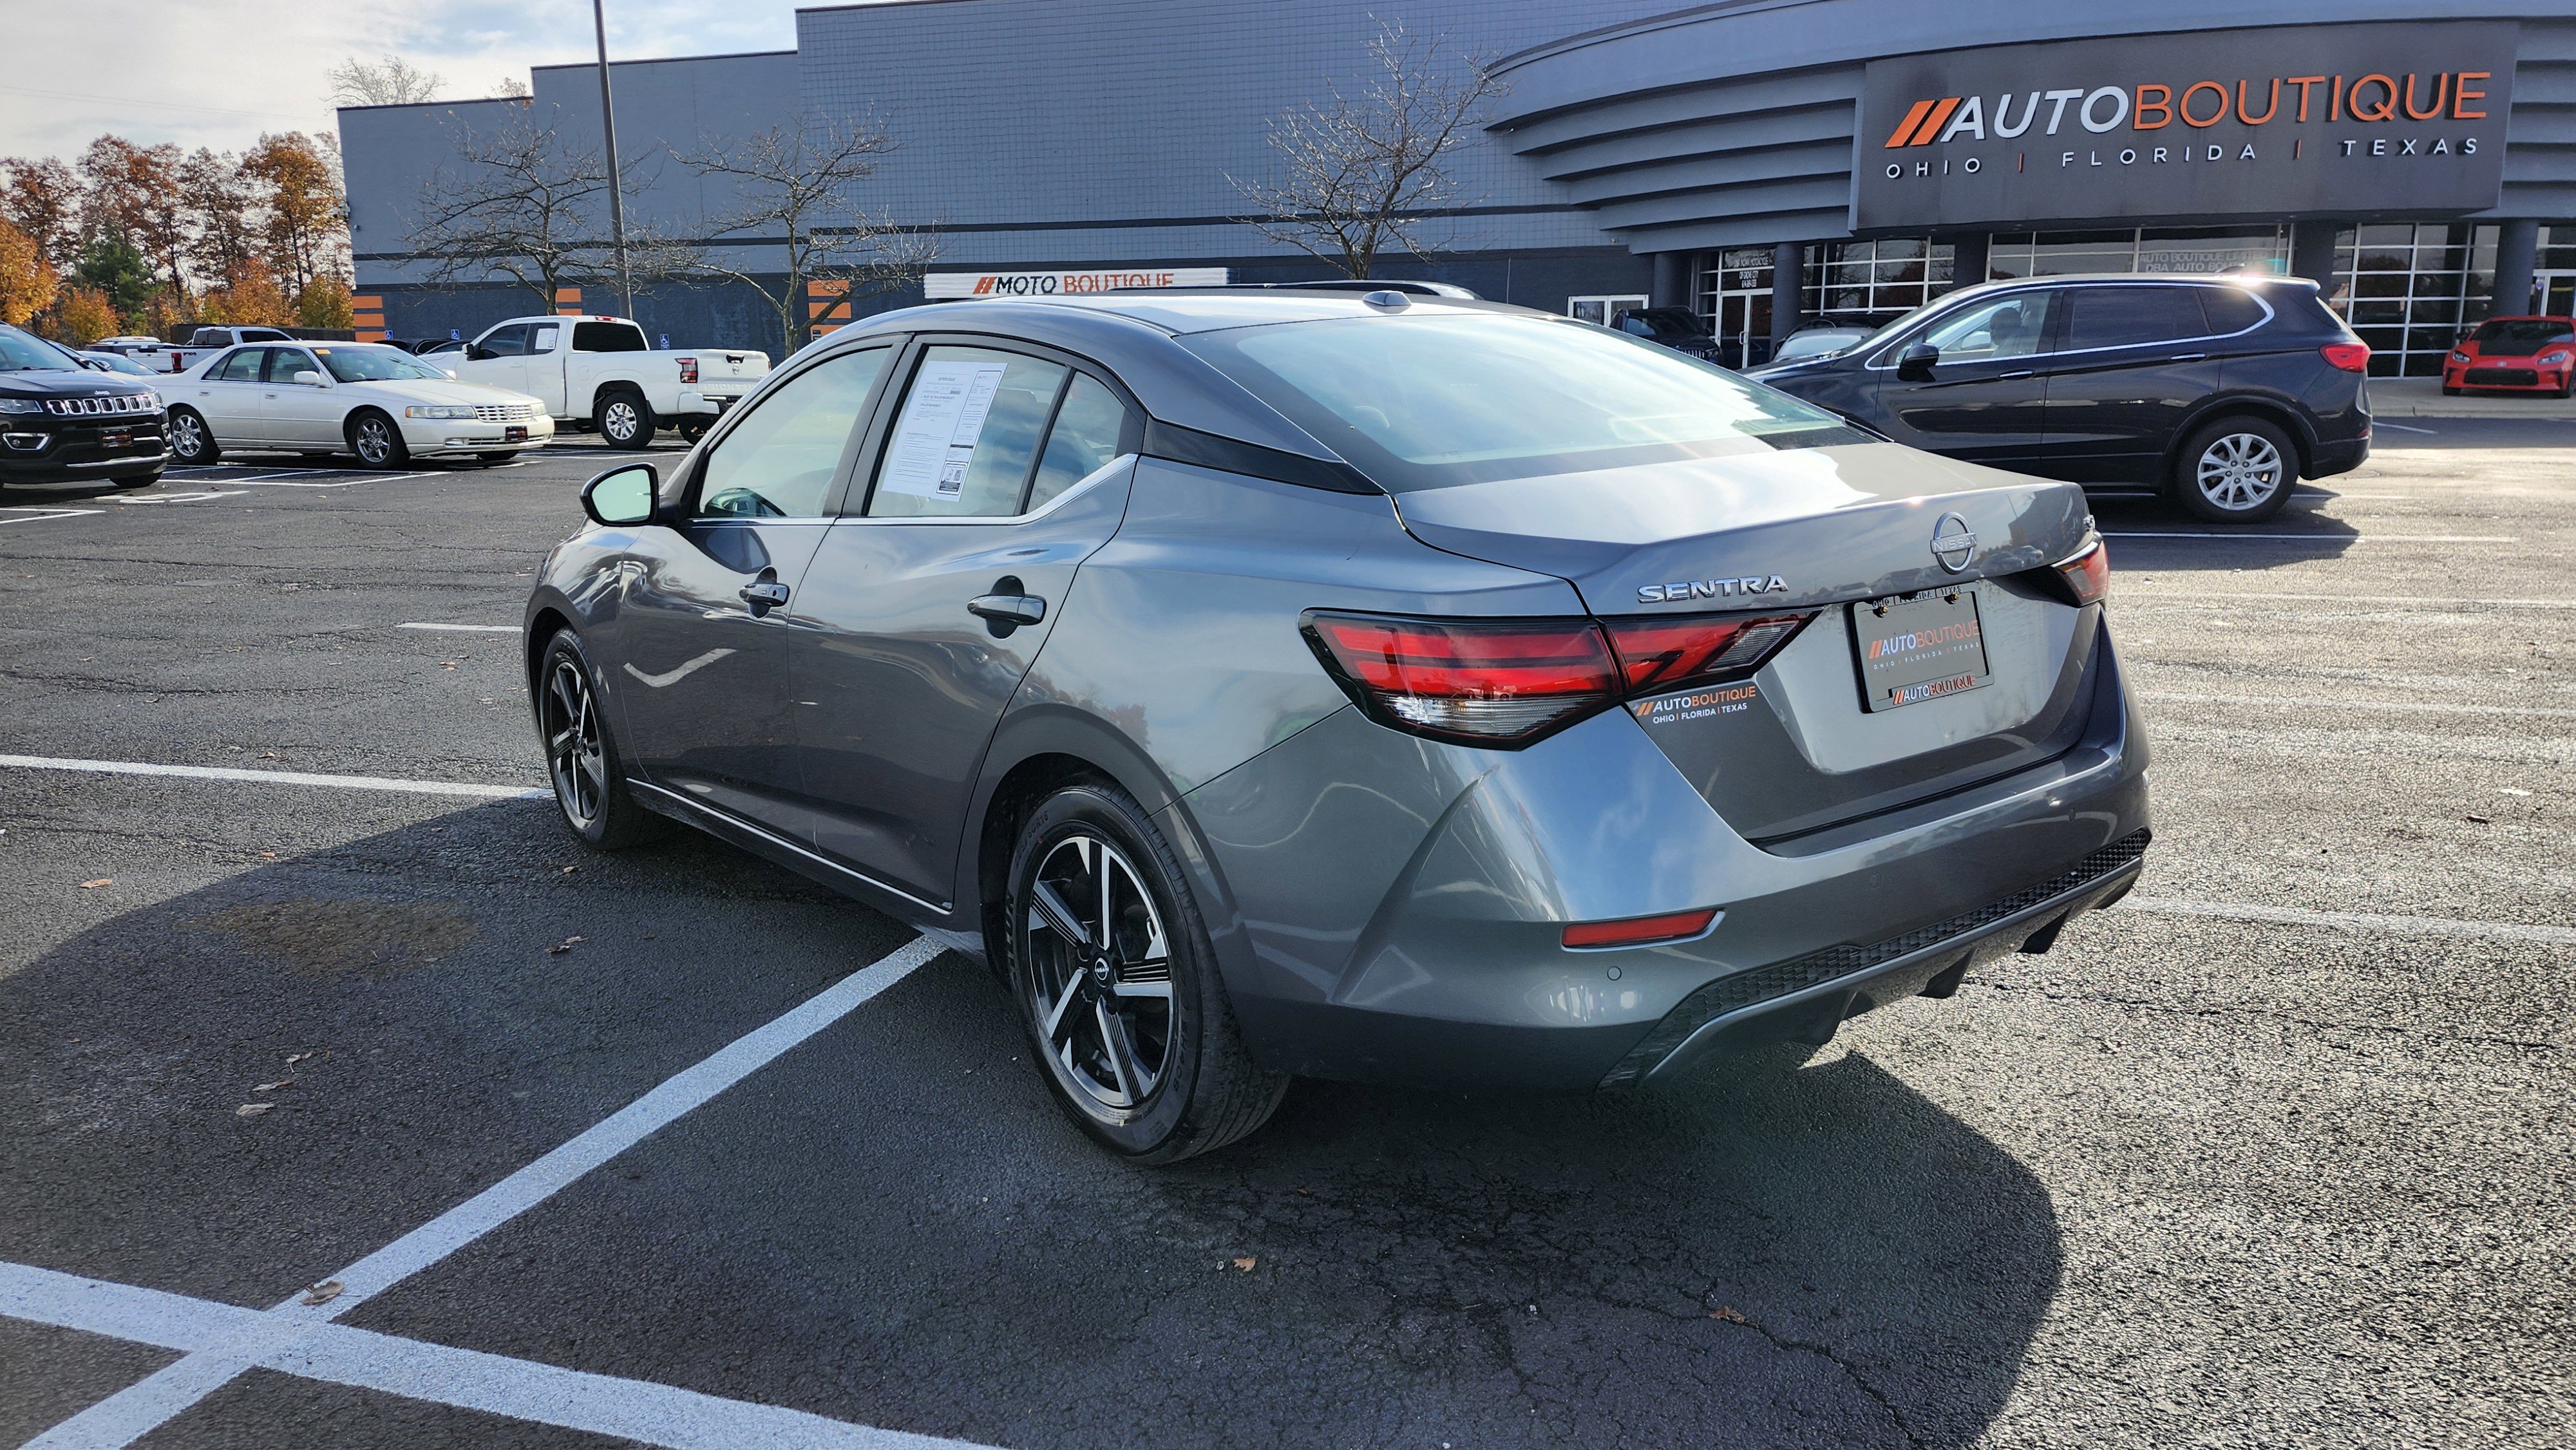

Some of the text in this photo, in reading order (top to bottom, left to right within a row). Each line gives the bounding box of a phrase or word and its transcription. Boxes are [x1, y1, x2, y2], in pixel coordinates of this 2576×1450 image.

[1940, 71, 2492, 143] AUTOBOUTIQUE
[1885, 137, 2477, 180] OHIO FLORIDA TEXAS
[2139, 252, 2169, 263] AUTO
[2171, 252, 2224, 262] BOUTIQUE
[2146, 263, 2168, 272] DBA
[2173, 262, 2204, 272] AUTO
[996, 273, 1174, 295] MOTO BOUTIQUE
[705, 382, 757, 391] FRONTI
[1933, 536, 1977, 551] NISSAN
[1637, 574, 1789, 604] SENTRA
[1940, 585, 1962, 596] TEXAS
[1873, 642, 1980, 670] OHIO FLORIDA TEXAS
[1653, 702, 1747, 724] OHIO FLORIDA TEXAS
